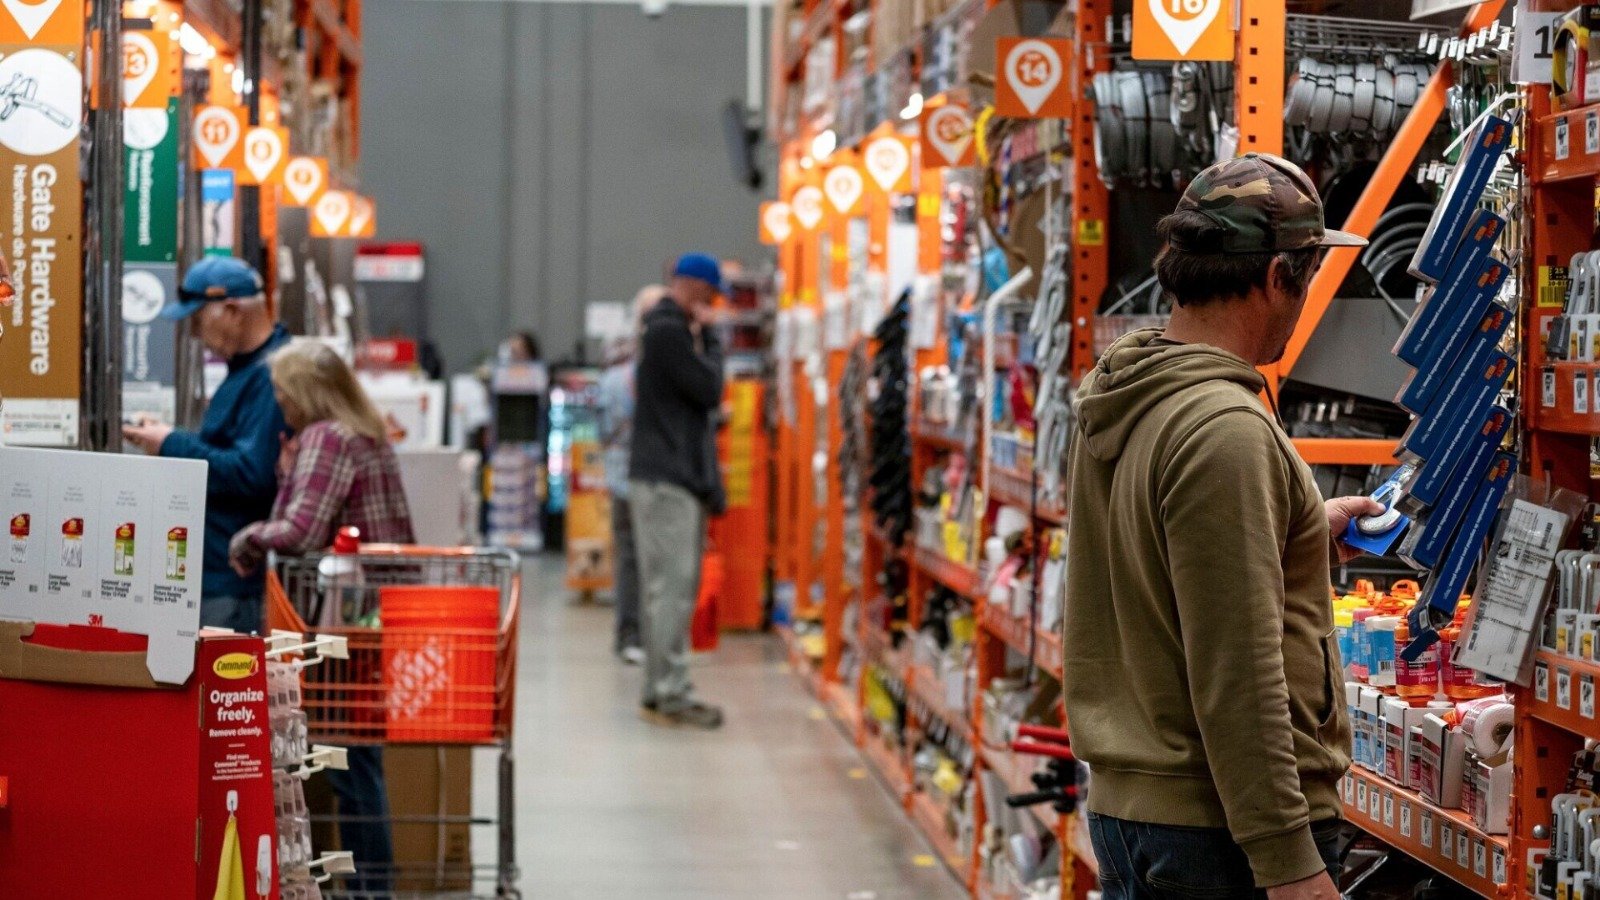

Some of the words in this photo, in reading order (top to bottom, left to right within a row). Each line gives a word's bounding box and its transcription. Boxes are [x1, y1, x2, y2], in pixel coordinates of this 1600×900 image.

[1020, 61, 1051, 83] 14
[12, 164, 27, 236] Hardware
[30, 163, 57, 232] Gate
[12, 238, 27, 258] de
[30, 238, 57, 375] Hardware
[88, 613, 103, 627] 3M
[216, 660, 252, 672] Command
[210, 687, 264, 707] Organize
[217, 706, 255, 724] freely.
[209, 728, 237, 738] Remove
[237, 726, 263, 737] cleanly.
